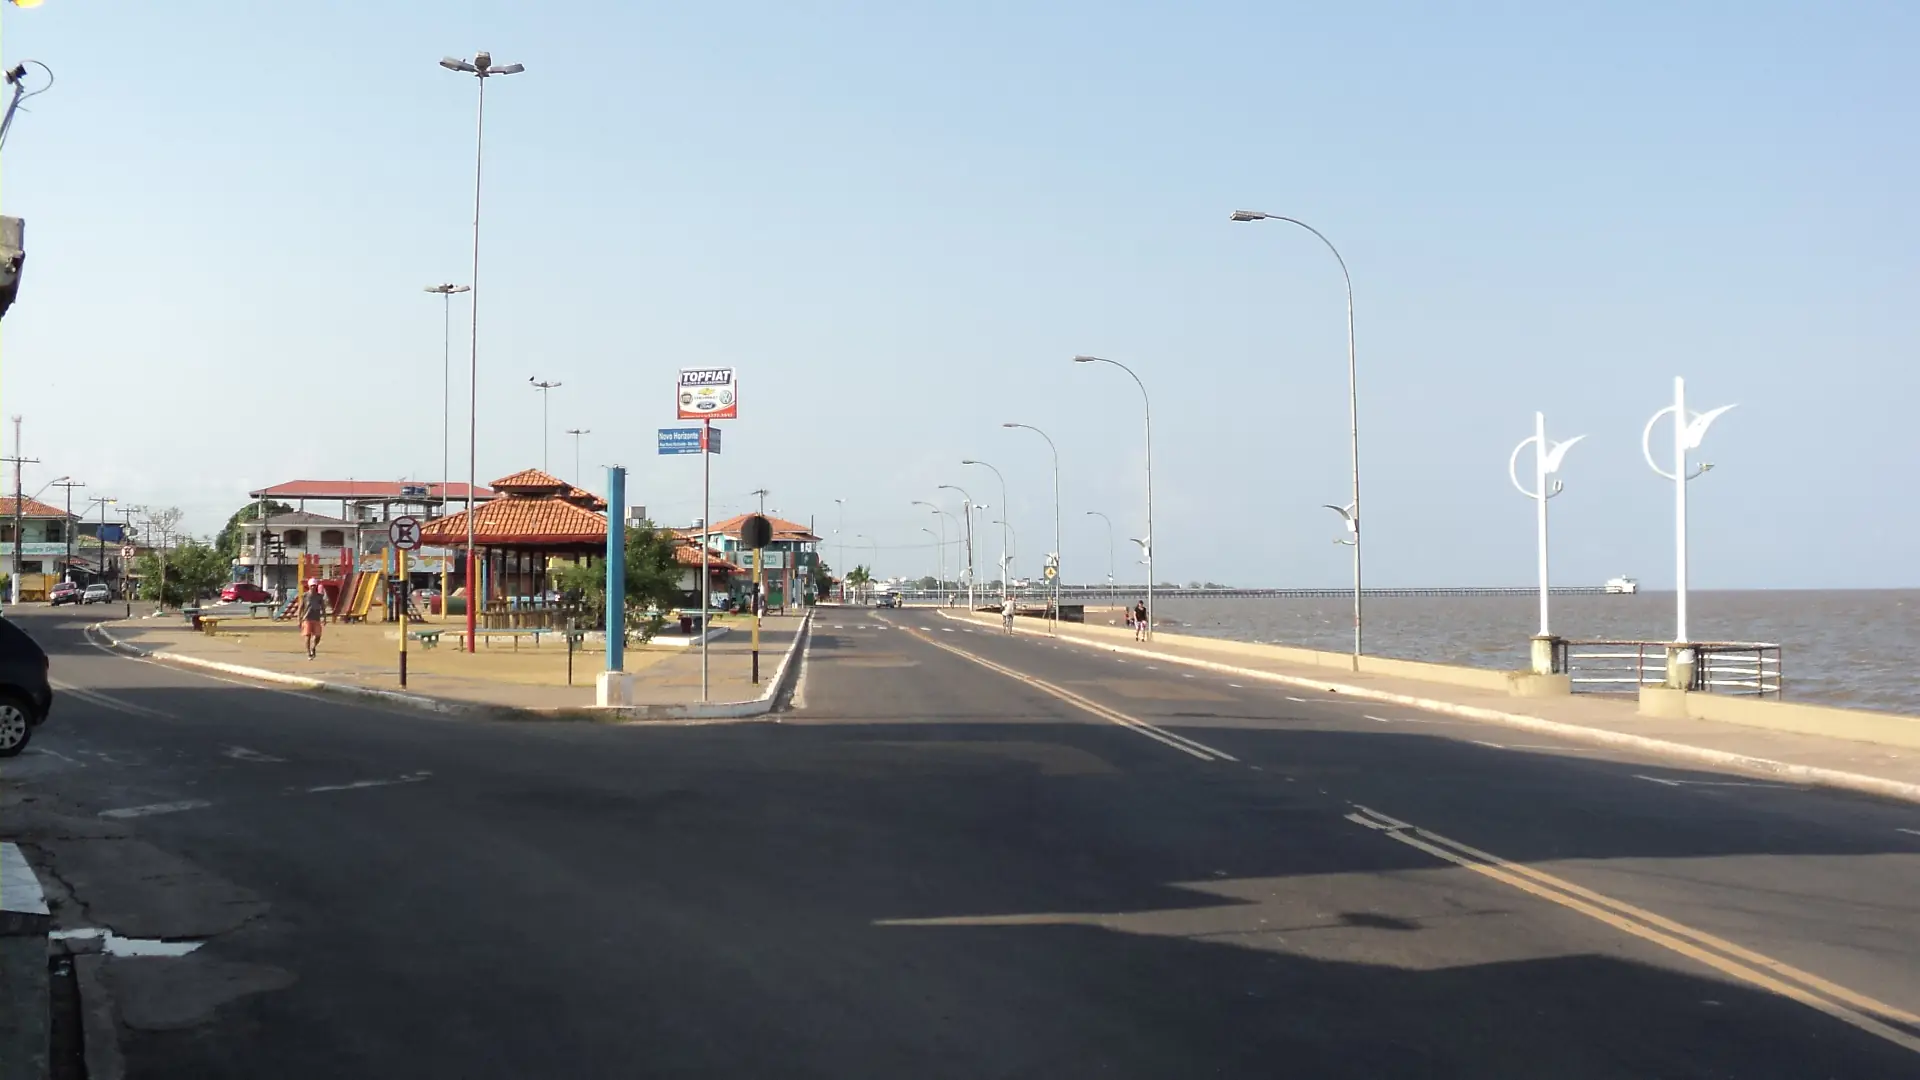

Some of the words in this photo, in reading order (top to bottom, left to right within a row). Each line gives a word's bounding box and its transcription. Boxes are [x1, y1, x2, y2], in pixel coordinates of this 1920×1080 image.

[683, 370, 730, 381] TOPFIAT
[659, 432, 672, 440] Novo
[673, 431, 698, 440] Horizonte
